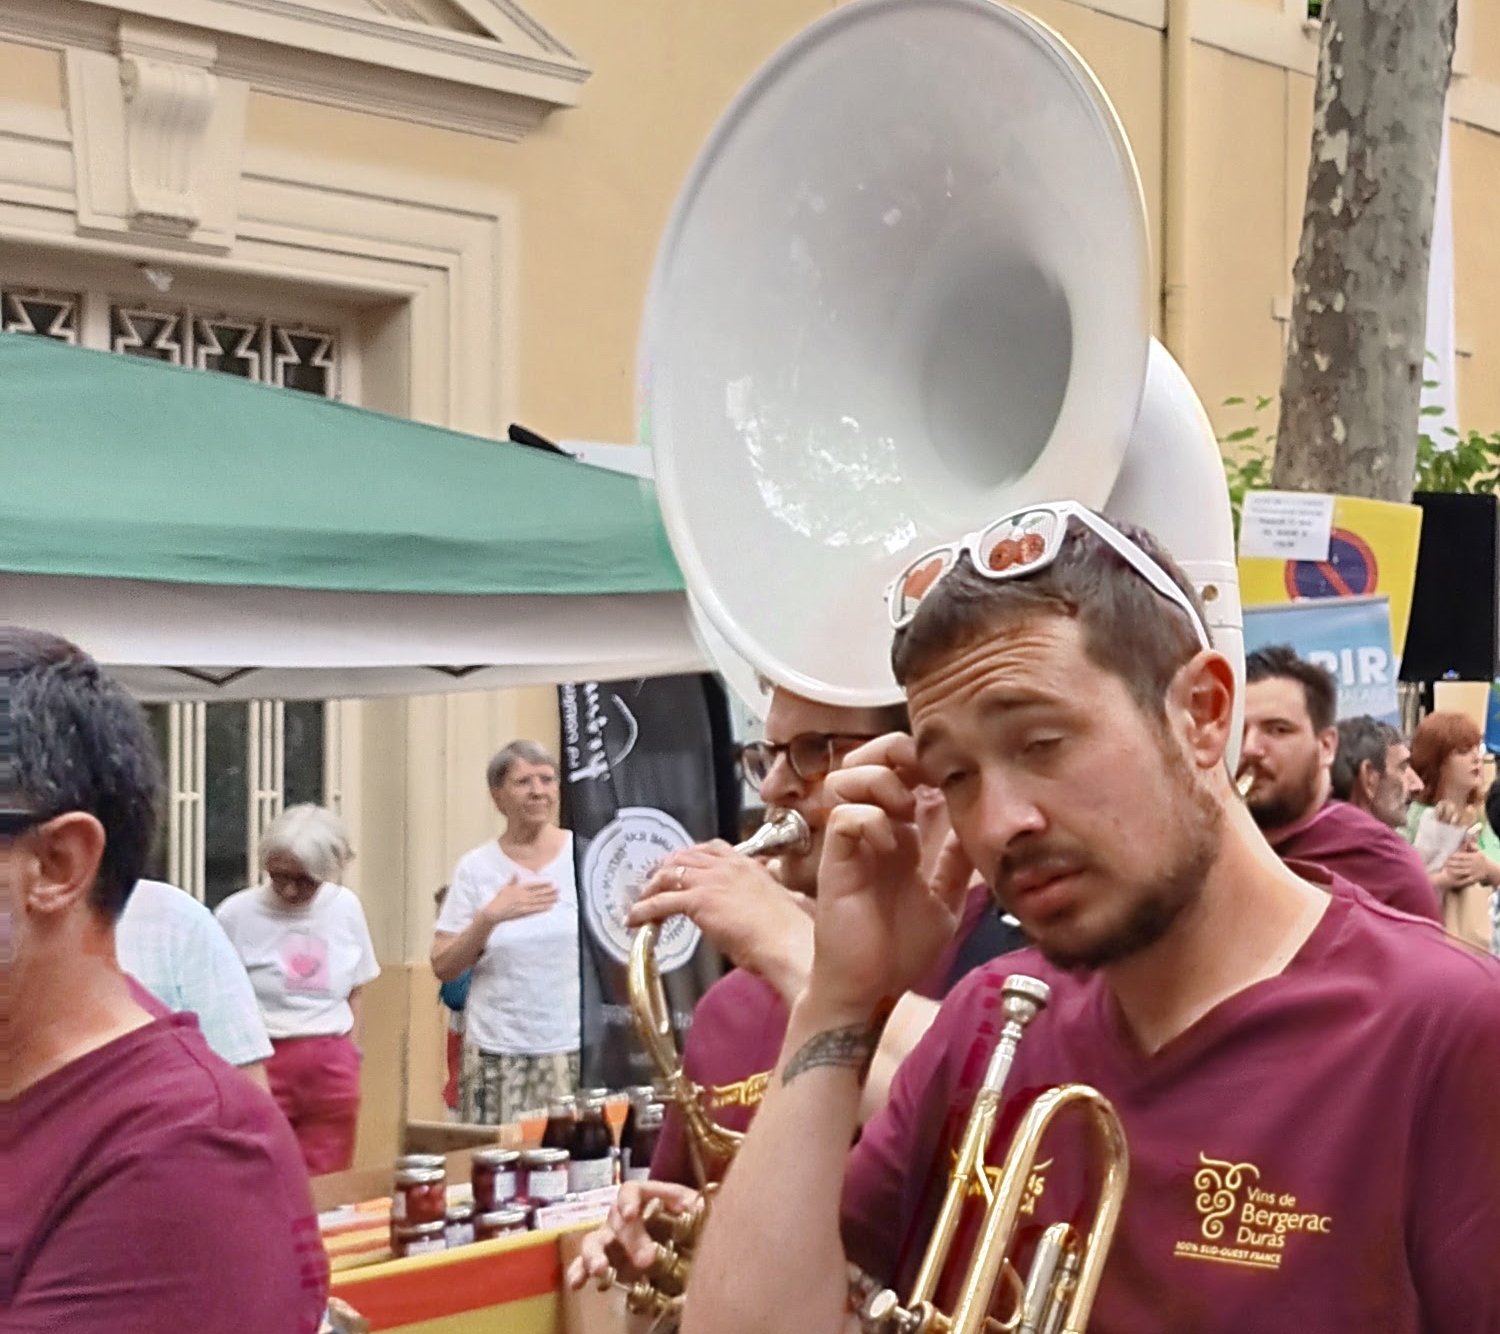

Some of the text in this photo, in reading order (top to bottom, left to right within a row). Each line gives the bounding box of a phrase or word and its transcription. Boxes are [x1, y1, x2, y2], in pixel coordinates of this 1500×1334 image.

[1247, 1186, 1297, 1207] Vins de
[1241, 1202, 1333, 1234] Bergerac
[1236, 1225, 1286, 1248] Duras
[1200, 1245, 1250, 1260] SUD-OUEST
[1249, 1252, 1283, 1264] FRANCE
